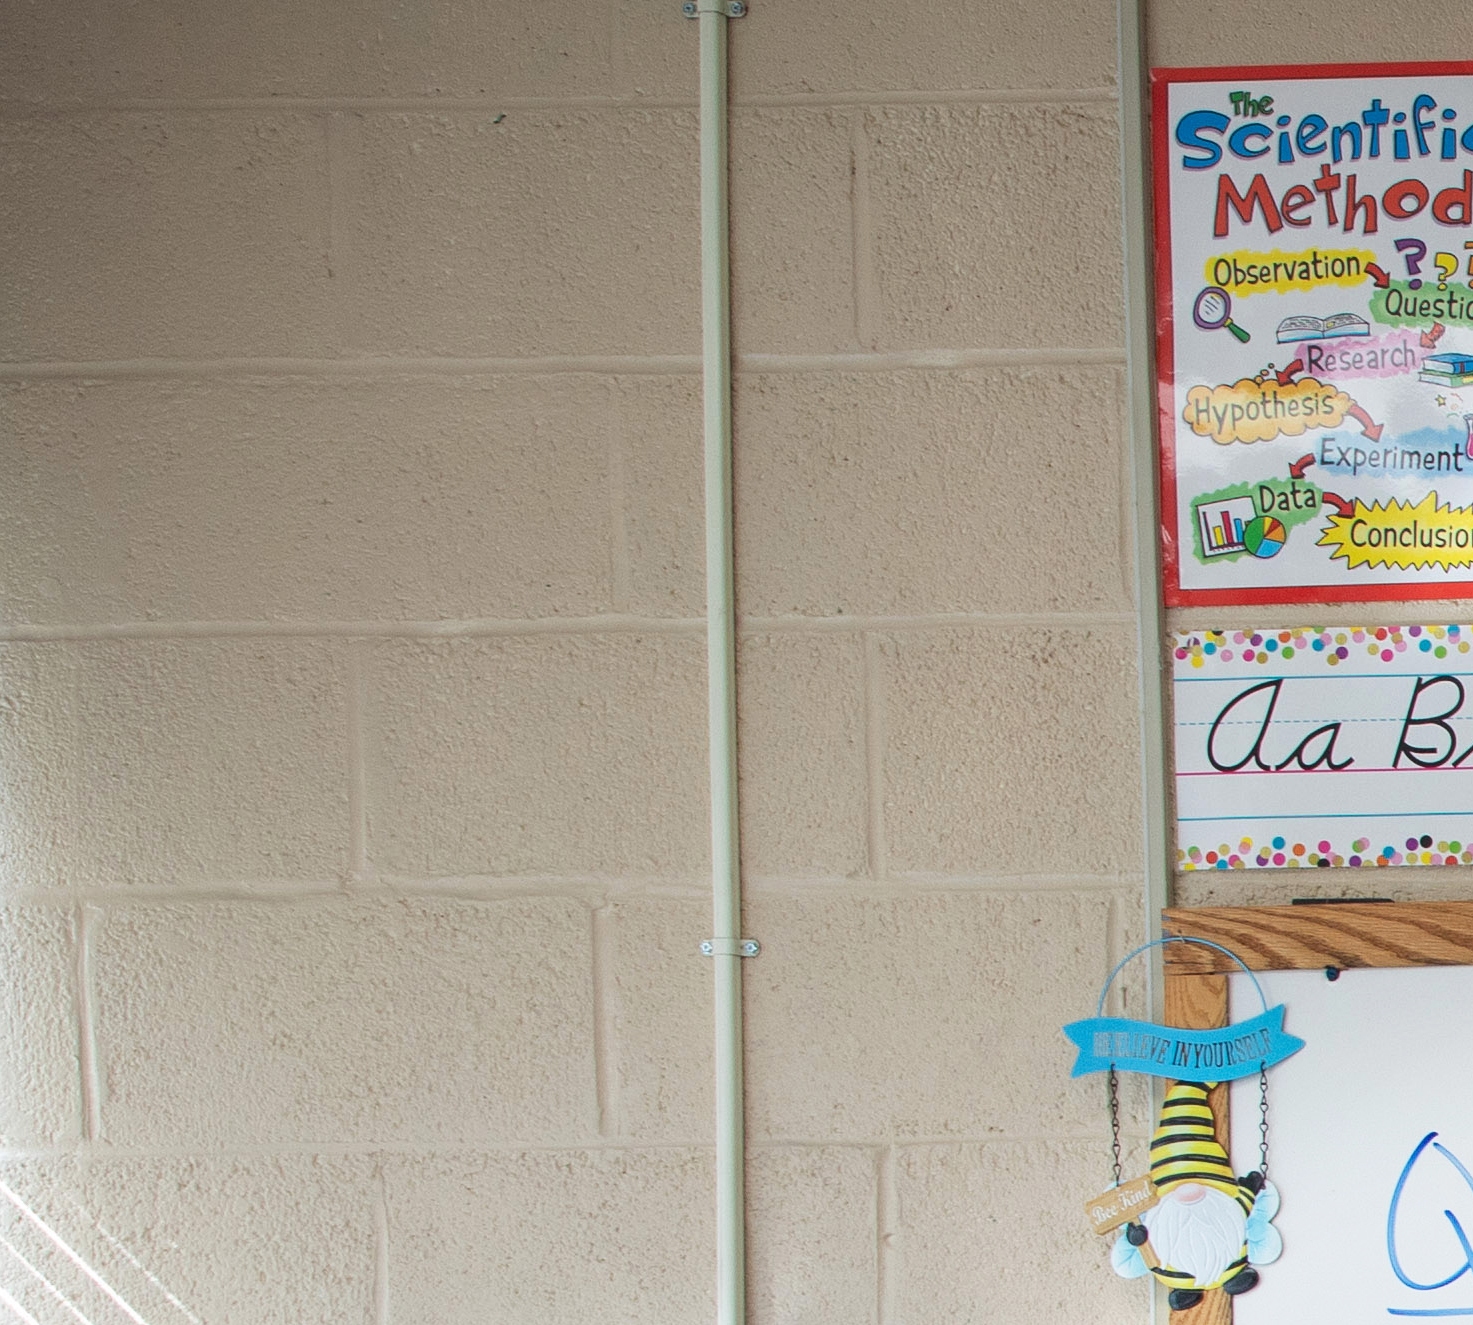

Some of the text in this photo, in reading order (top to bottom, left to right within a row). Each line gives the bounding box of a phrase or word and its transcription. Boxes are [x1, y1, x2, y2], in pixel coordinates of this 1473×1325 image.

[1230, 91, 1273, 119] The
[1213, 251, 1362, 288] Observation
[1306, 341, 1416, 375] Research
[1192, 392, 1335, 430] Hypothesis
[1320, 438, 1465, 474] Experiment
[1259, 482, 1316, 513] Data
[1194, 1028, 1271, 1068] YOURSELF
[1118, 1180, 1152, 1211] Kind
